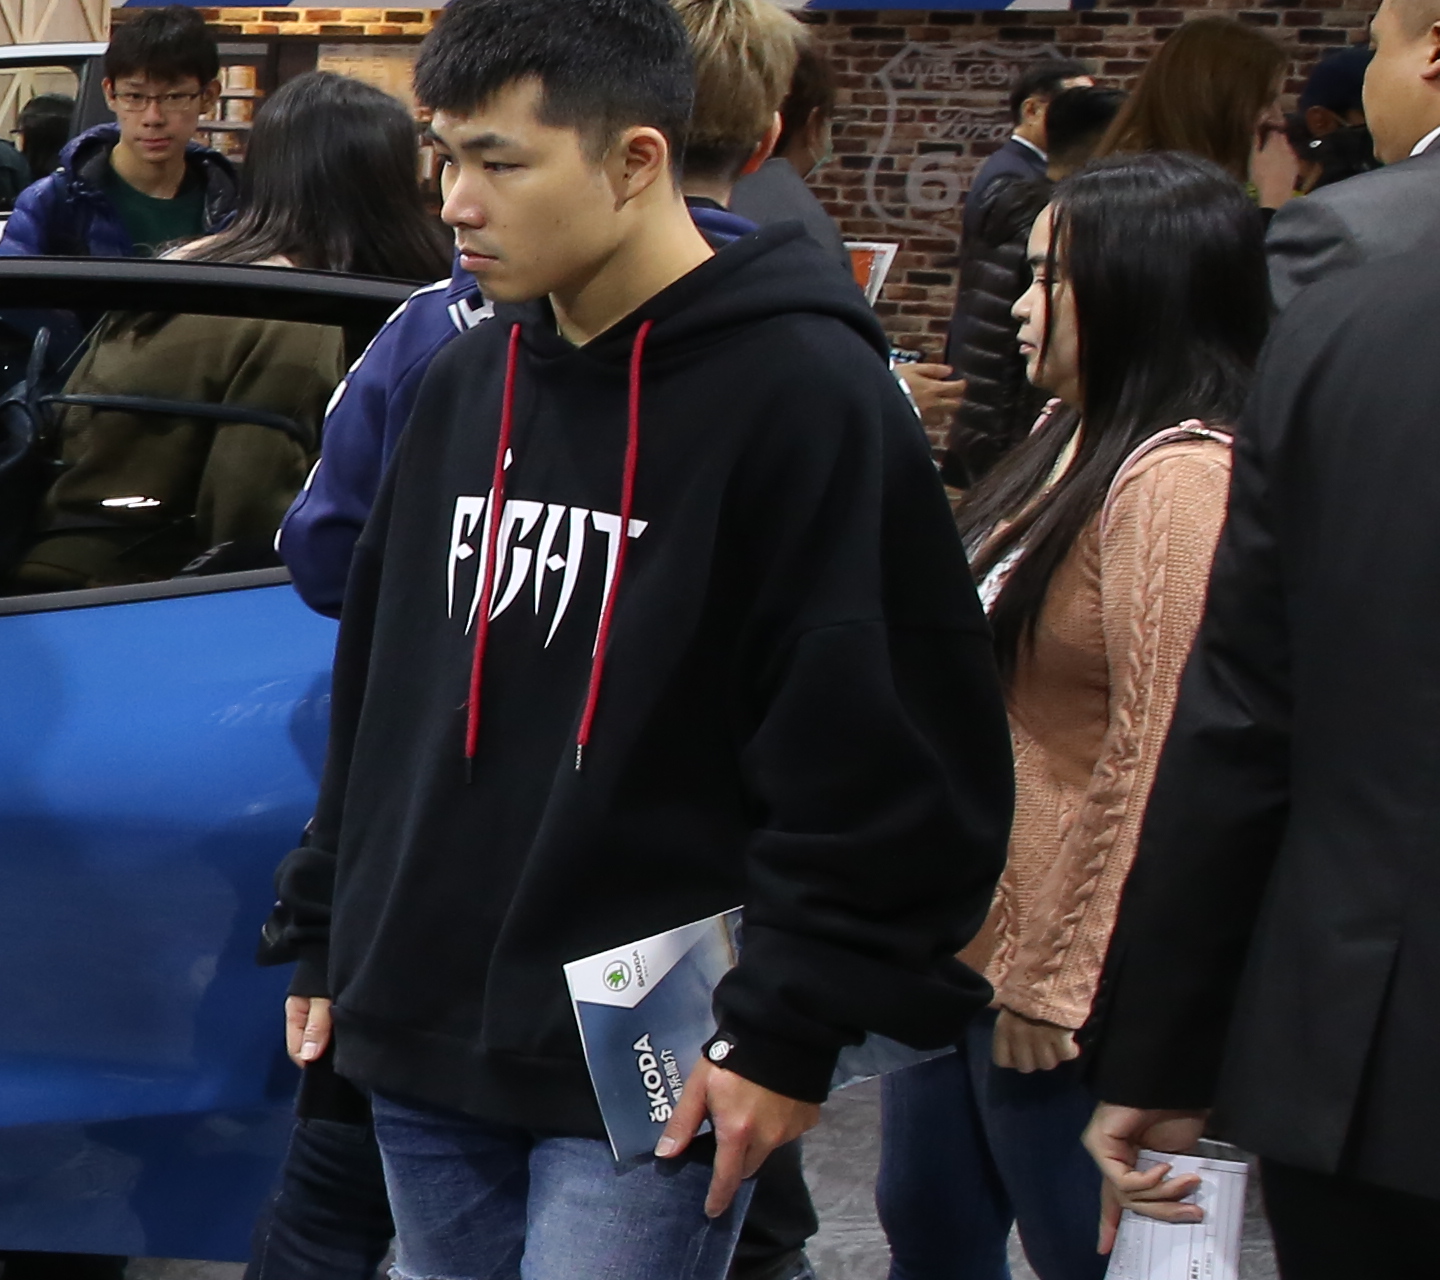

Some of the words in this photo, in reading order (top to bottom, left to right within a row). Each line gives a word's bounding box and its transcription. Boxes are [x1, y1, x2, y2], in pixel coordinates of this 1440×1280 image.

[900, 61, 1019, 85] WELCOM
[447, 447, 649, 658] FIGHT
[632, 1033, 673, 1123] ŠKODA
